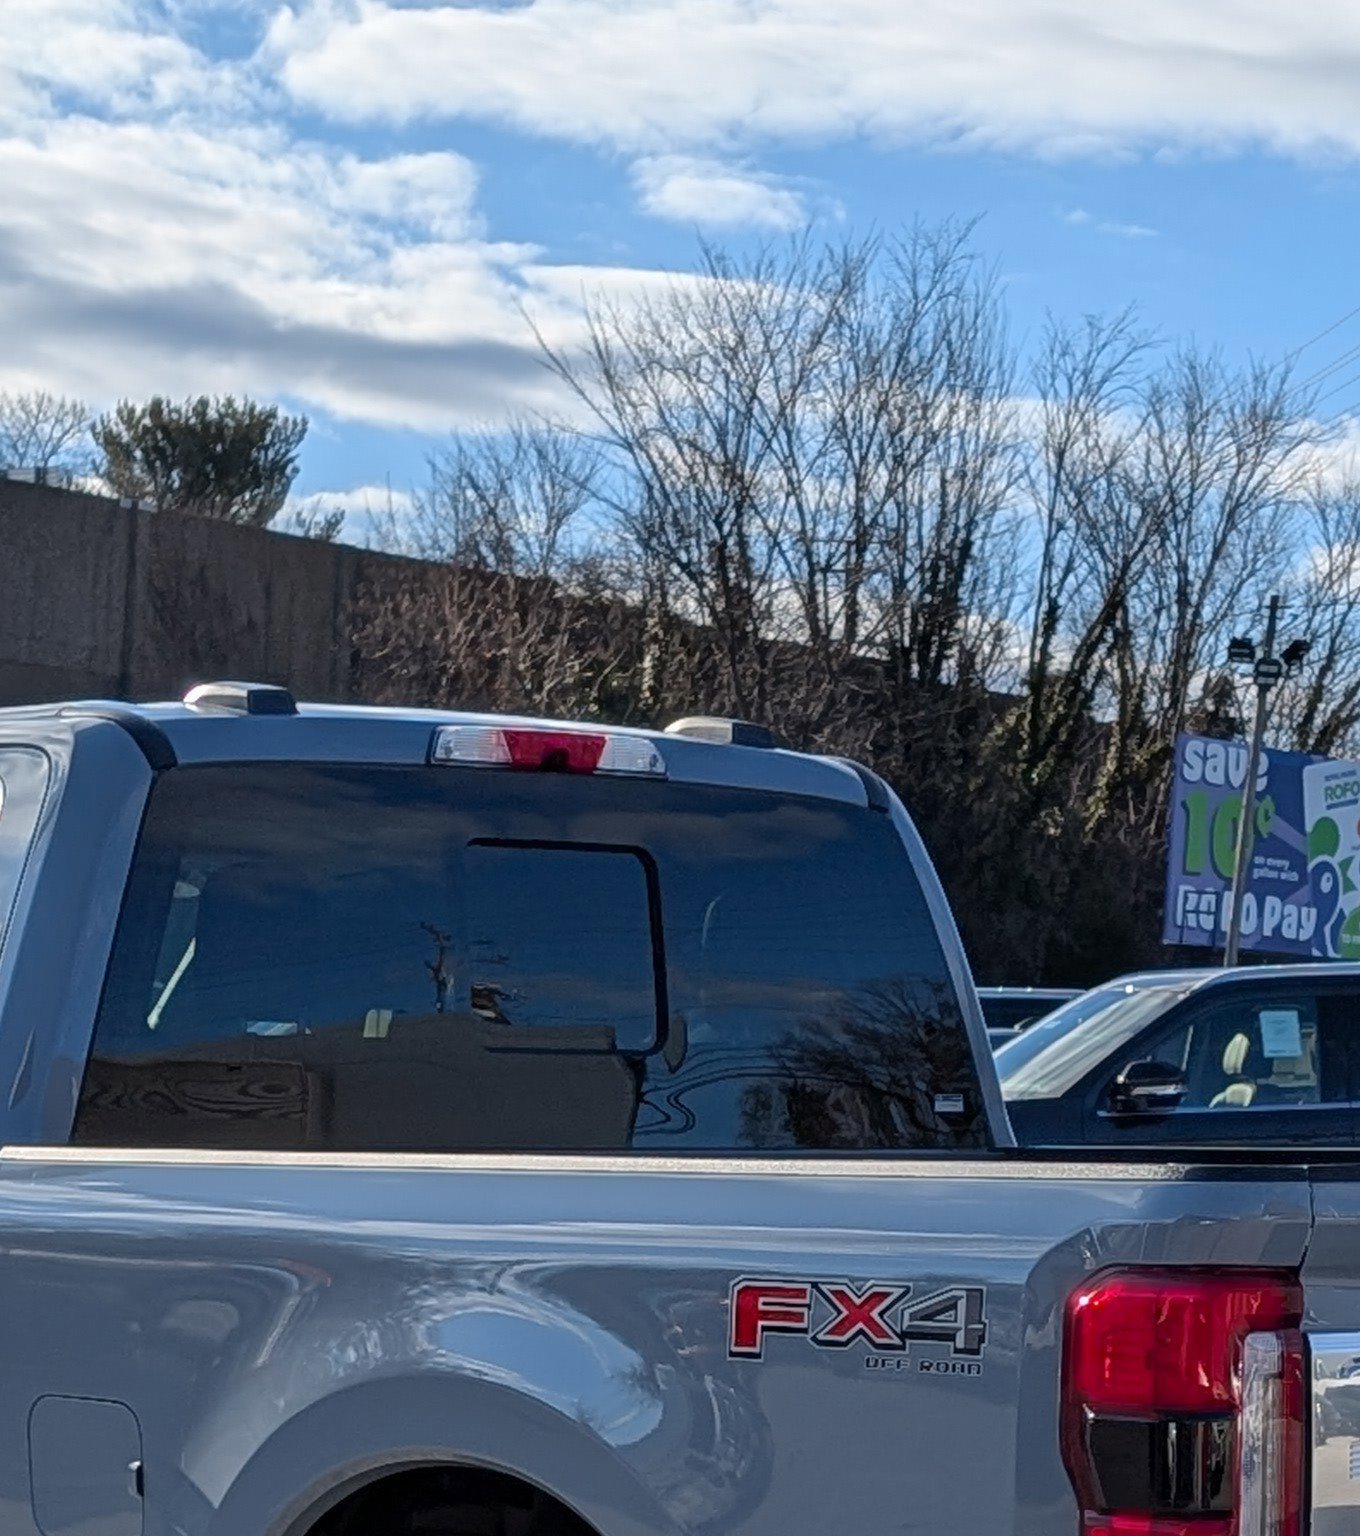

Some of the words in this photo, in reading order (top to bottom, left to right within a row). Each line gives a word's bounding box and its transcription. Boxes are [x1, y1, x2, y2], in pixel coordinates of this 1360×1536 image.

[1263, 895, 1318, 942] Pay
[727, 1274, 988, 1361] FX4
[864, 1355, 910, 1371] OFF
